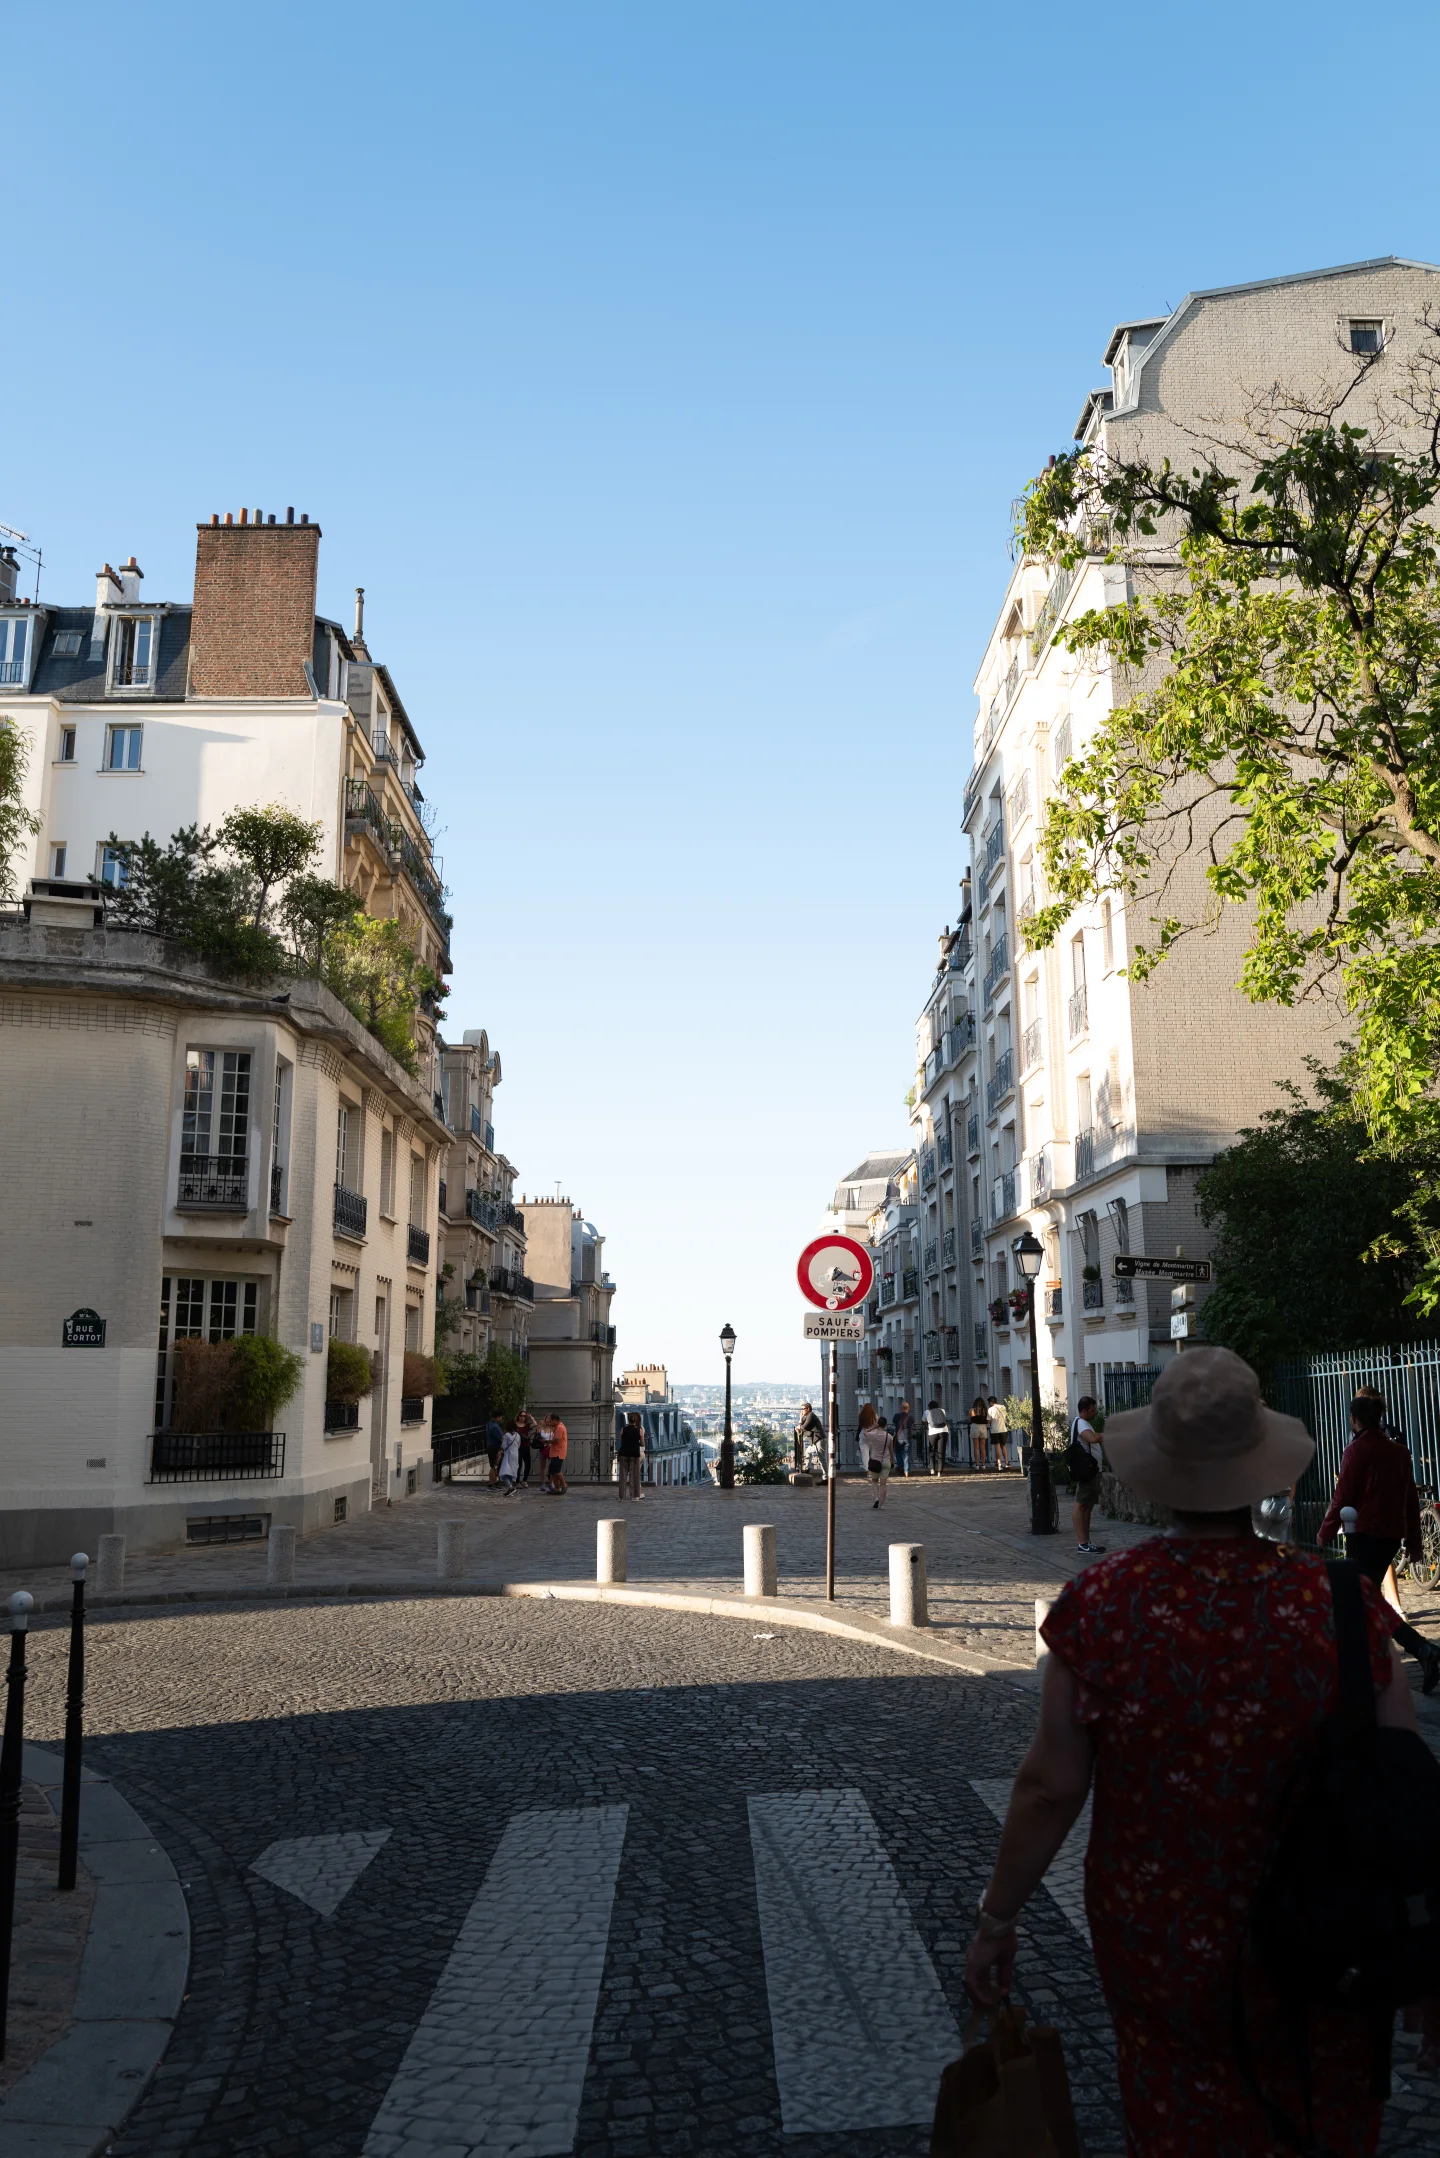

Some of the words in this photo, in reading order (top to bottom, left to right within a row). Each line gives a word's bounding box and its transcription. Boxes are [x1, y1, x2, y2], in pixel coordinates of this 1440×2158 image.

[1134, 1260, 1151, 1268] Vigne
[1161, 1262, 1195, 1270] Montmartre
[1158, 1269, 1195, 1277] Montmartre
[818, 1317, 850, 1327] SAUF
[75, 1325, 94, 1333] RUE
[806, 1327, 861, 1338] POMPIERS
[67, 1334, 102, 1342] CORTOT
